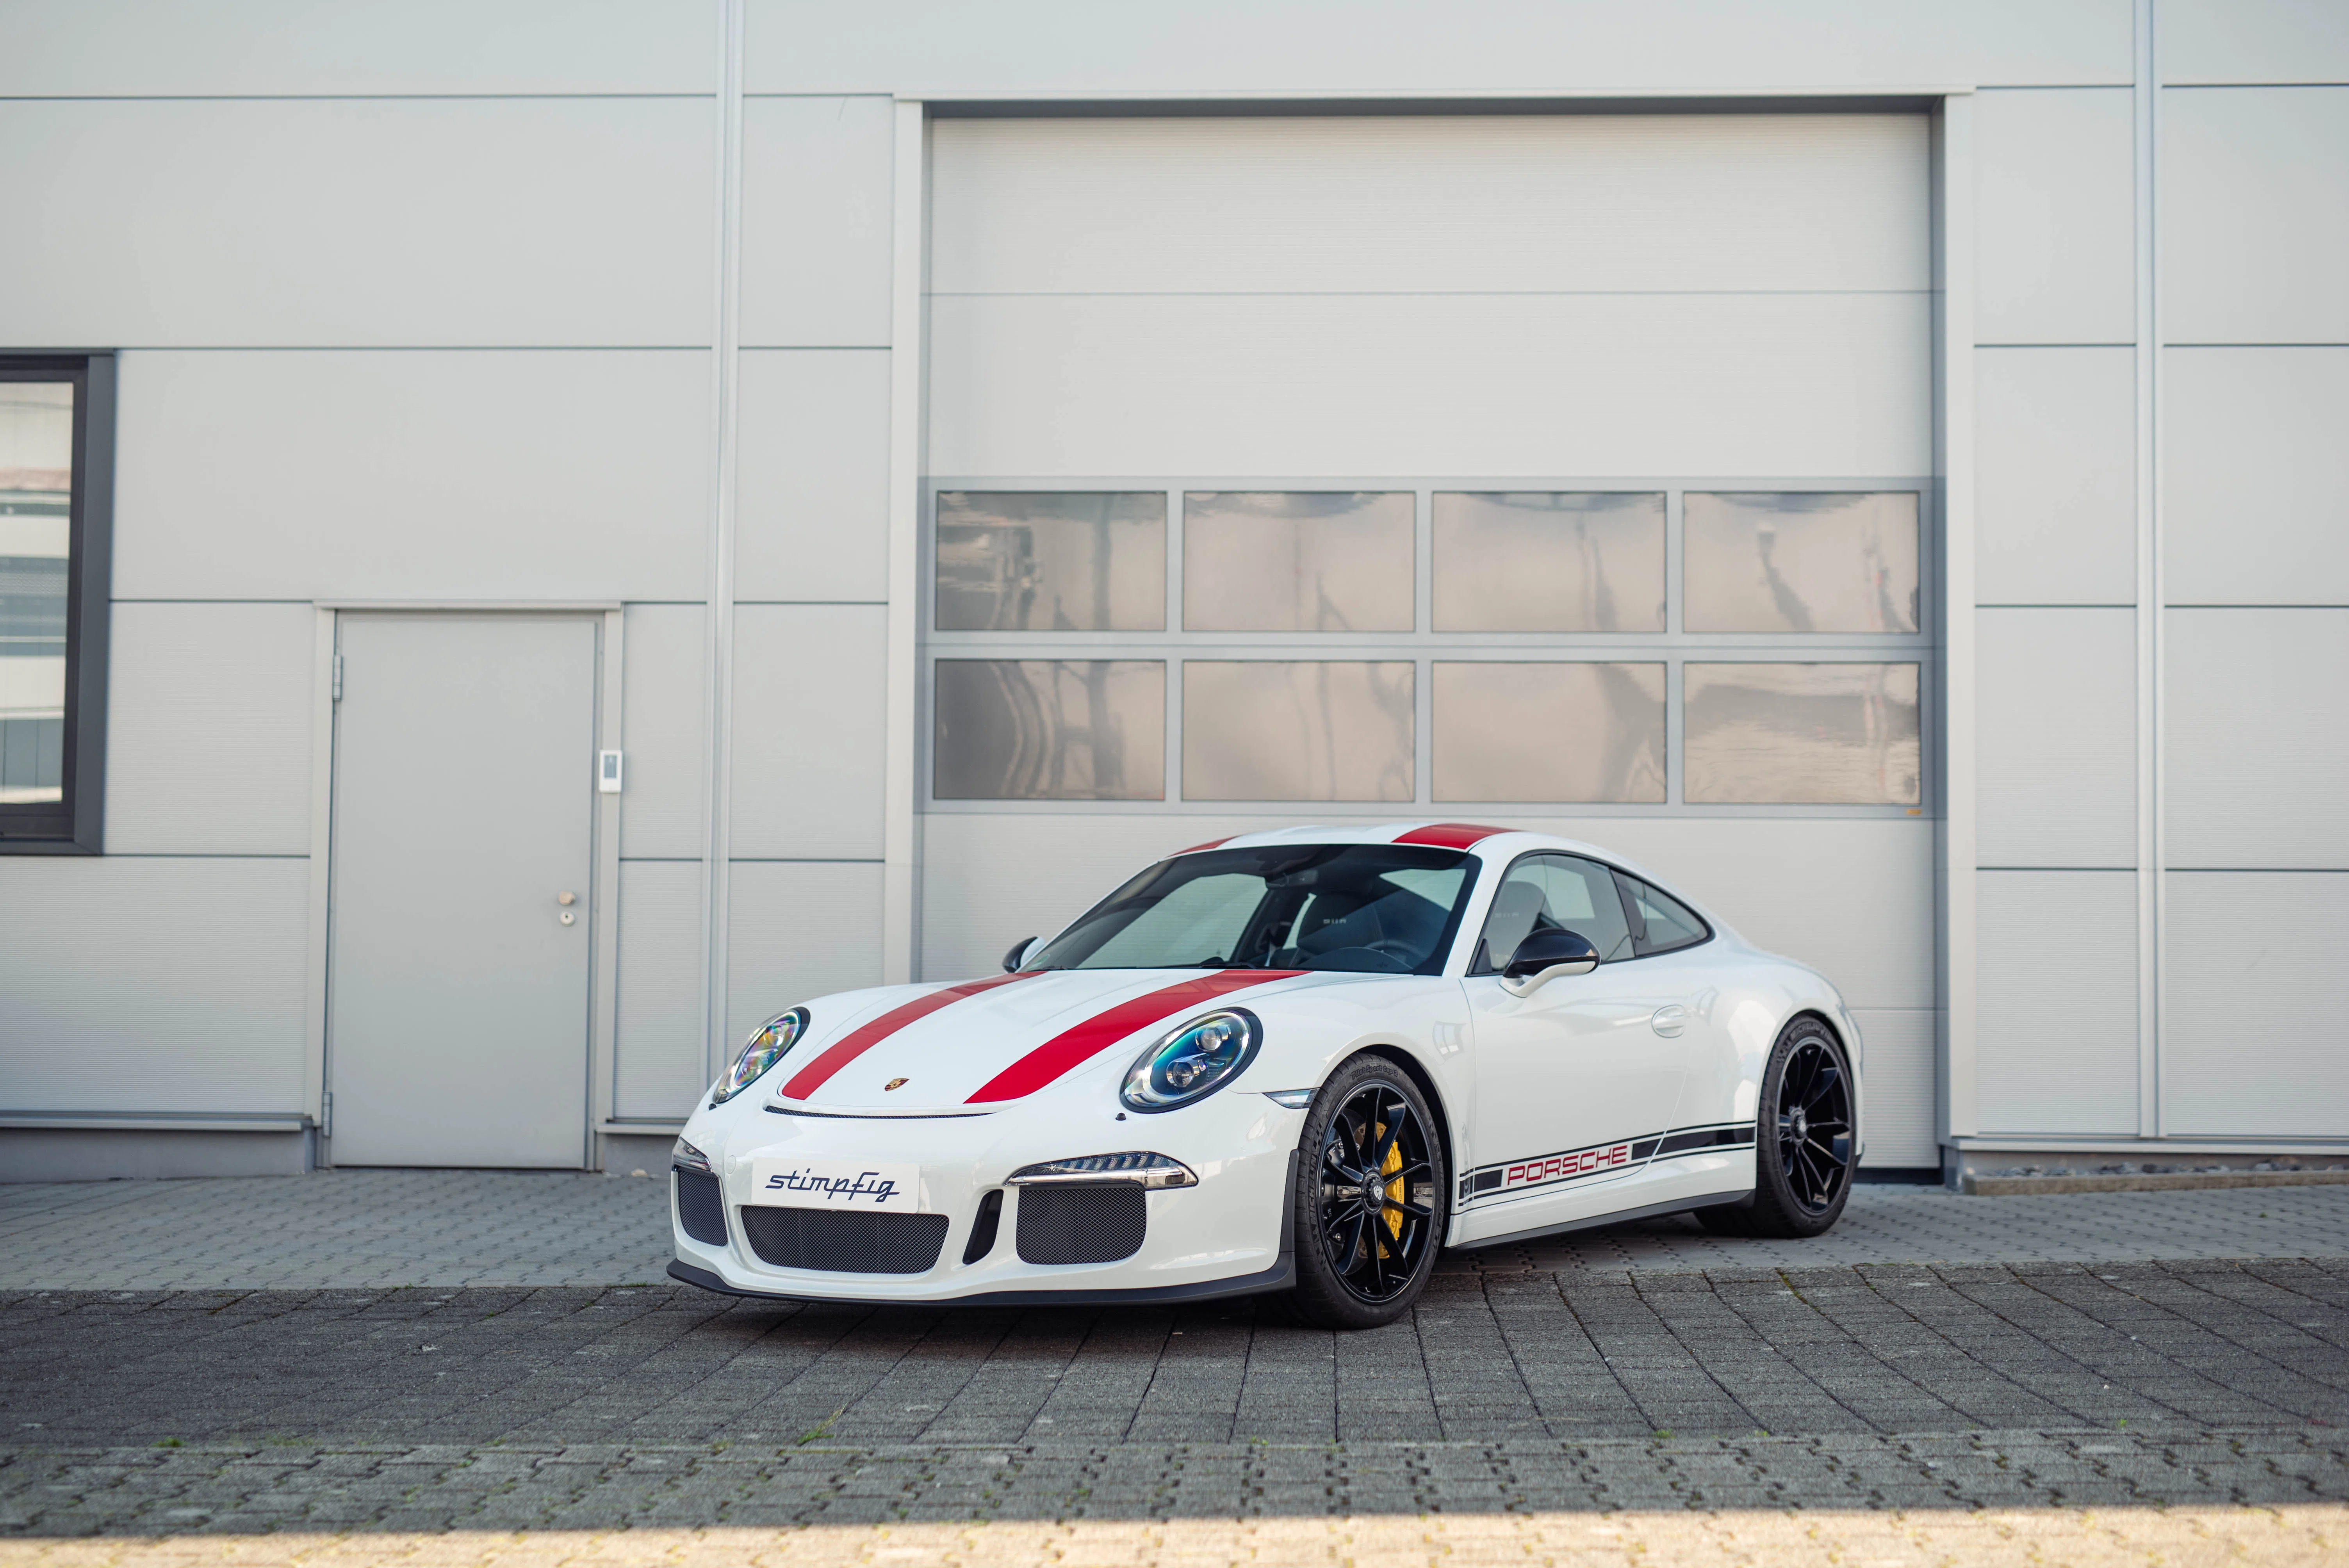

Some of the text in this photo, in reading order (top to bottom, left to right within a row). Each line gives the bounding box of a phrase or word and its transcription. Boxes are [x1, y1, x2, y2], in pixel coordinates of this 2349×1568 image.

[1351, 1067, 1366, 1080] Pilot
[1366, 1065, 1382, 1073] Sport
[1383, 1066, 1393, 1074] Cup
[1508, 1145, 1627, 1185] PORSCHE
[765, 1168, 900, 1202] stimpfig
[1308, 1153, 1317, 1224] MICHELIN
